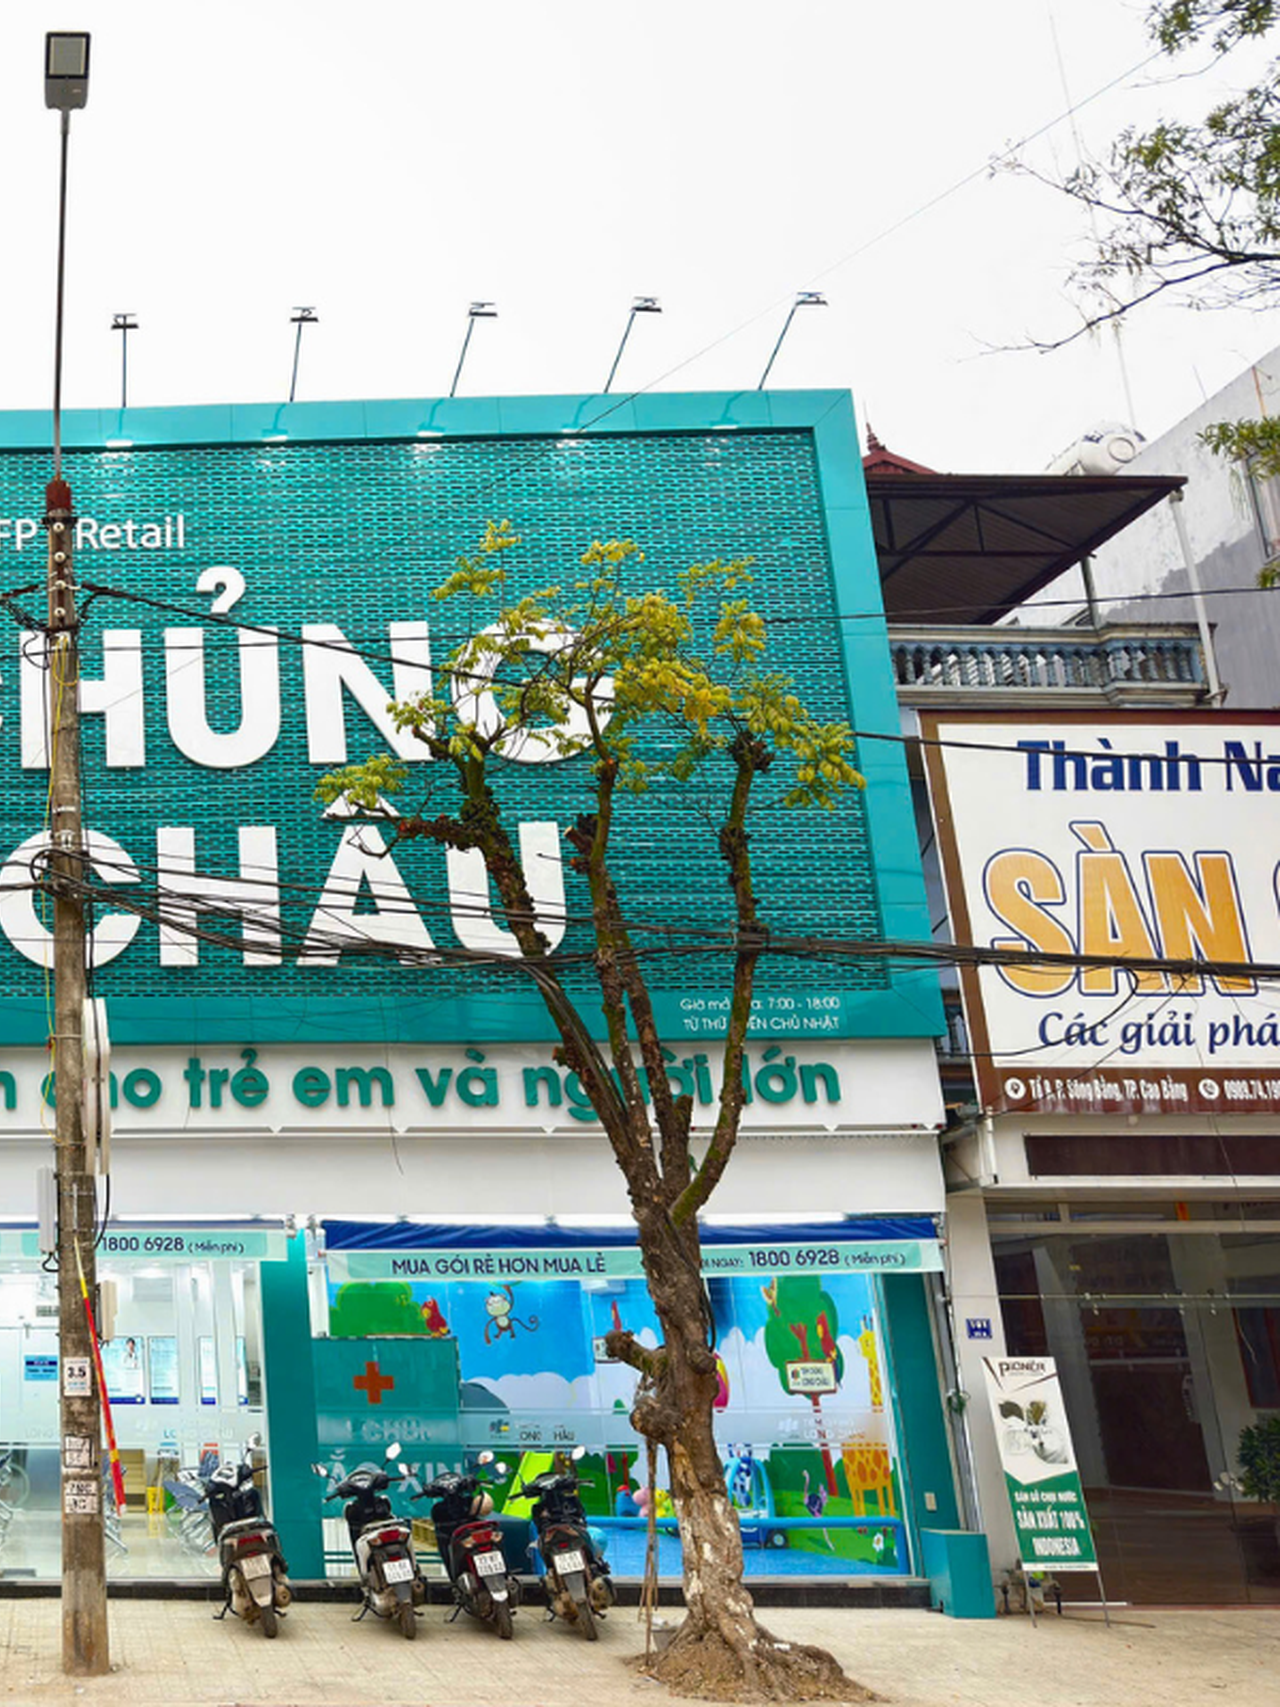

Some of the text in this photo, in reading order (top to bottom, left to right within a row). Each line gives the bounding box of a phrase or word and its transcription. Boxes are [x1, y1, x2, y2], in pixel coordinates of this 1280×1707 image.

[76, 514, 184, 550] Retail
[1017, 737, 1202, 792] Thành
[983, 821, 1258, 997] SÀN
[1038, 1011, 1109, 1047] Các
[1120, 1010, 1195, 1055] giải
[184, 1048, 269, 1109] trẻ
[293, 1064, 395, 1106] em
[415, 1047, 500, 1106] và
[101, 1236, 140, 1251] 1800
[143, 1236, 184, 1251] 6928
[748, 1251, 791, 1267] 1800
[794, 1249, 840, 1266] 6928
[392, 1259, 431, 1275] MUA
[499, 1256, 539, 1273] HƠN
[543, 1256, 583, 1273] MUA
